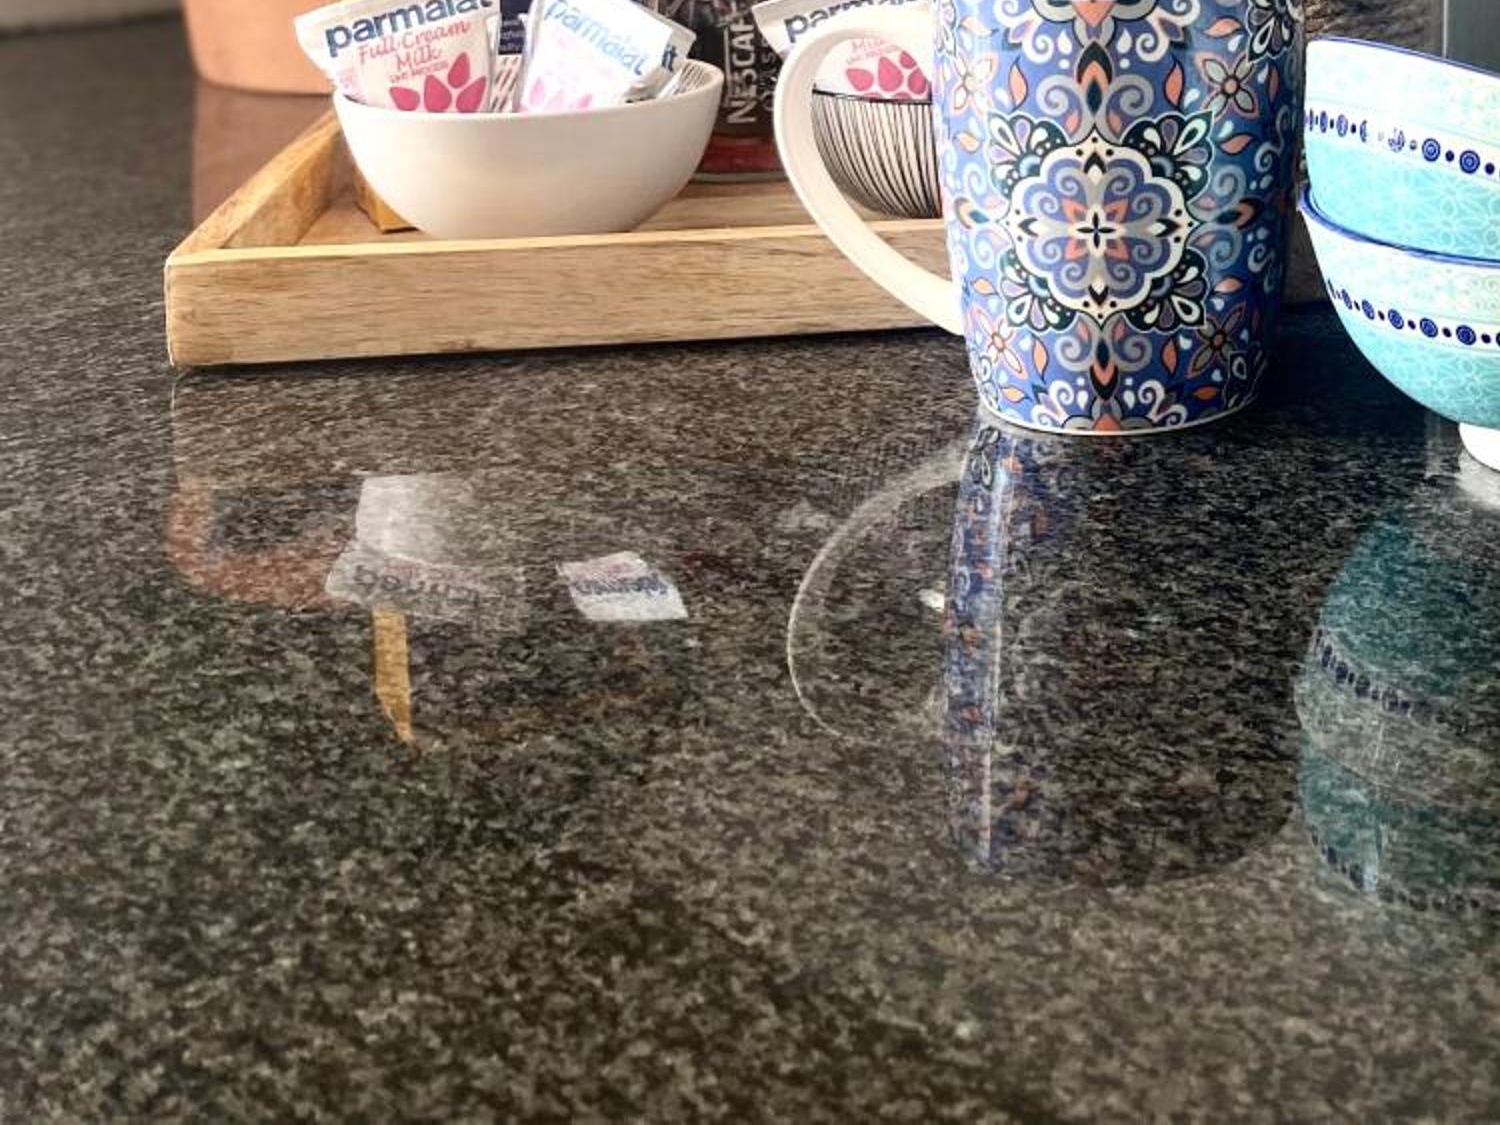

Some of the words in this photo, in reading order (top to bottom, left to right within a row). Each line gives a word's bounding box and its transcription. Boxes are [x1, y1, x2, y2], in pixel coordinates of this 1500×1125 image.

[357, 37, 397, 65] Full
[401, 21, 472, 50] Cream
[394, 45, 443, 72] Milk
